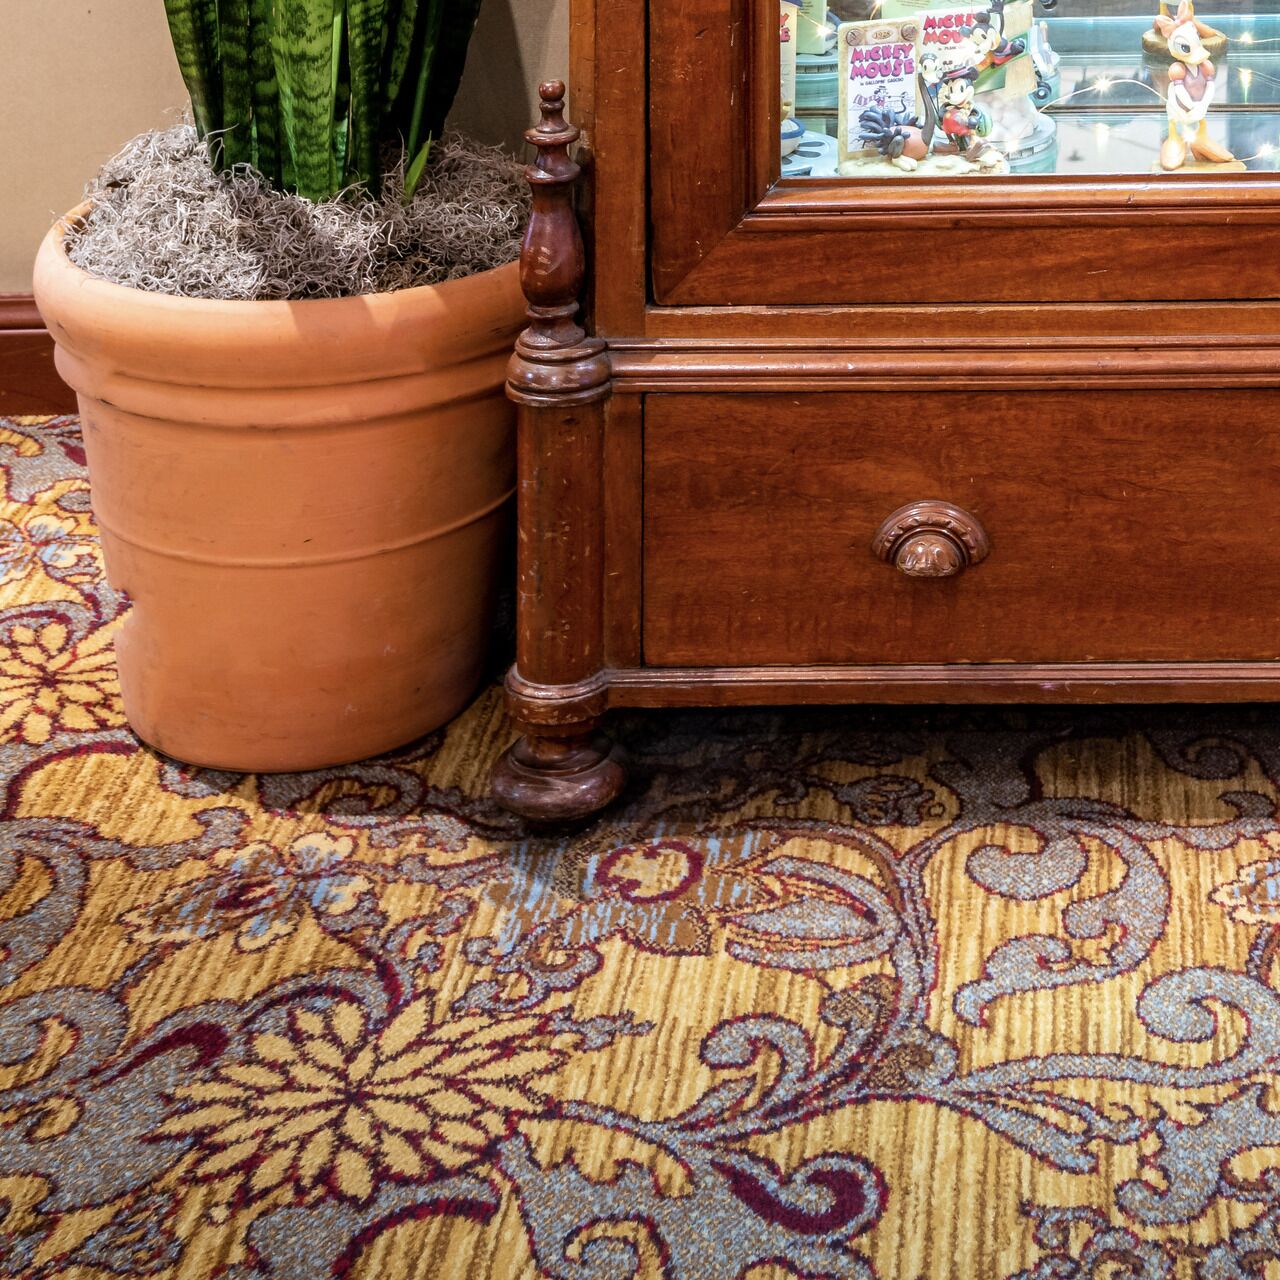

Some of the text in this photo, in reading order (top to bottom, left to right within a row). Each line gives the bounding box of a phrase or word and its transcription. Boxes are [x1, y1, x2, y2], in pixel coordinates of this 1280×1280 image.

[923, 14, 977, 30] MICKE
[922, 29, 962, 45] MOU
[850, 43, 914, 64] MICKEY
[850, 58, 915, 80] MOUSE
